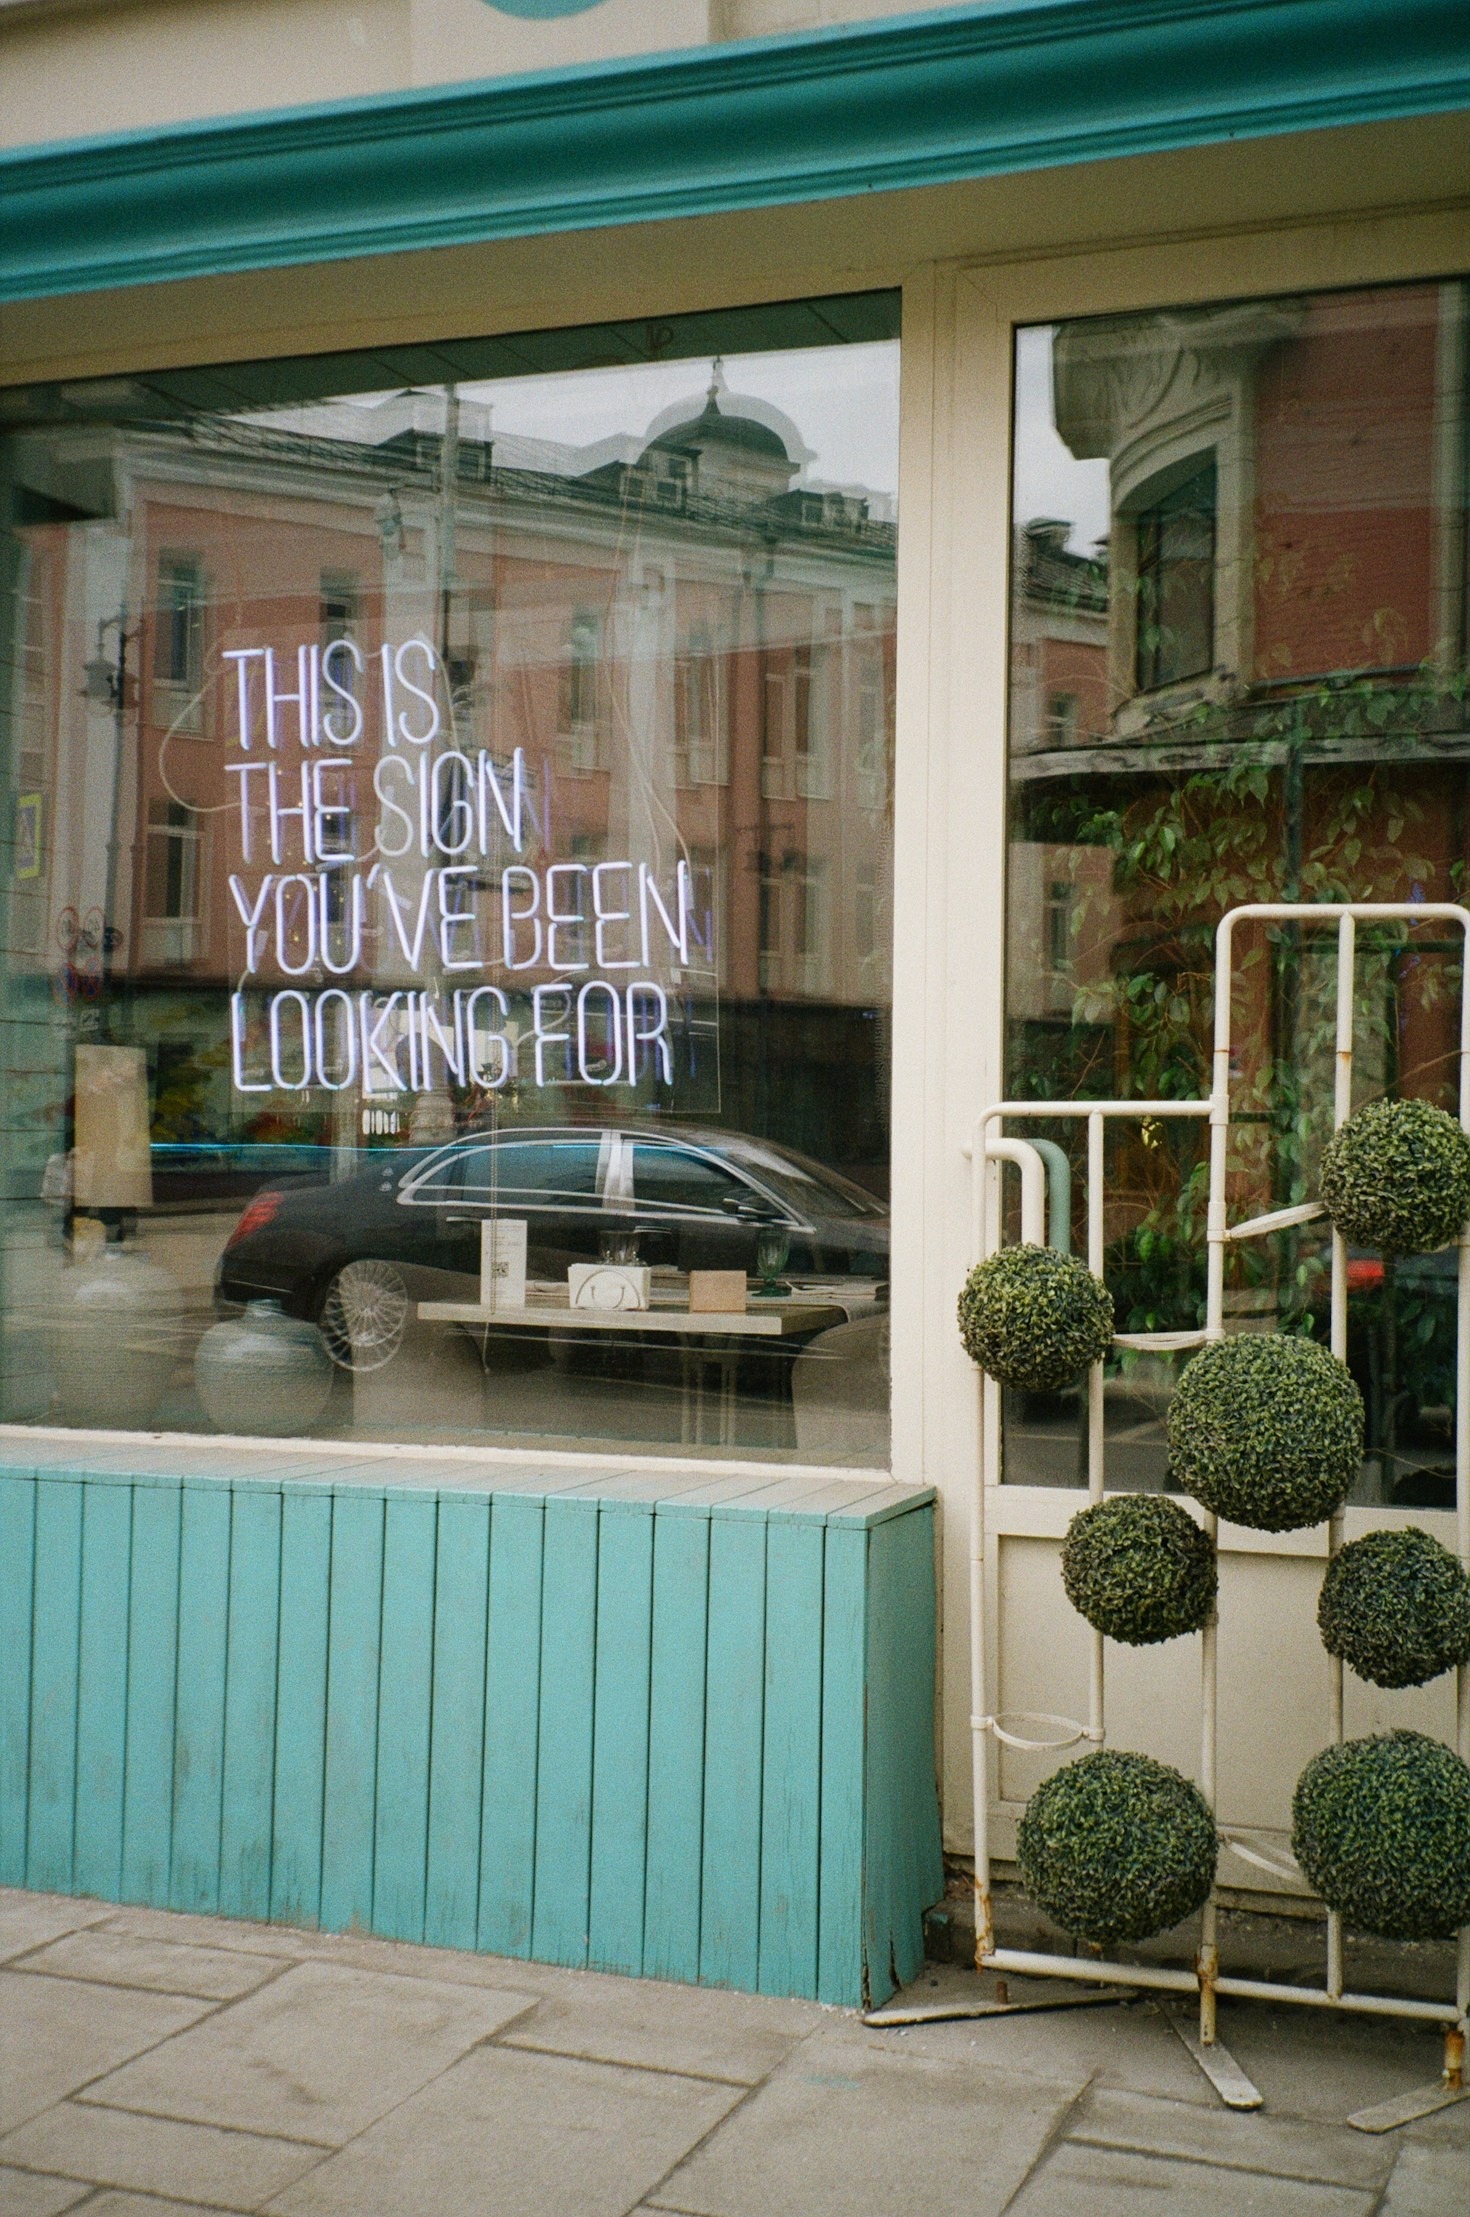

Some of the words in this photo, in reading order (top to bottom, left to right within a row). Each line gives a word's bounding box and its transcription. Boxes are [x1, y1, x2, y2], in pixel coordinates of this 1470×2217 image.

[222, 640, 363, 750] THIS
[379, 640, 439, 747] IS
[224, 758, 355, 865] THE
[373, 747, 523, 858] SIGN
[229, 863, 483, 975] YOU'VE
[502, 860, 690, 972] BEEN
[231, 985, 510, 1093] LOOKING
[533, 980, 674, 1088] FOR
